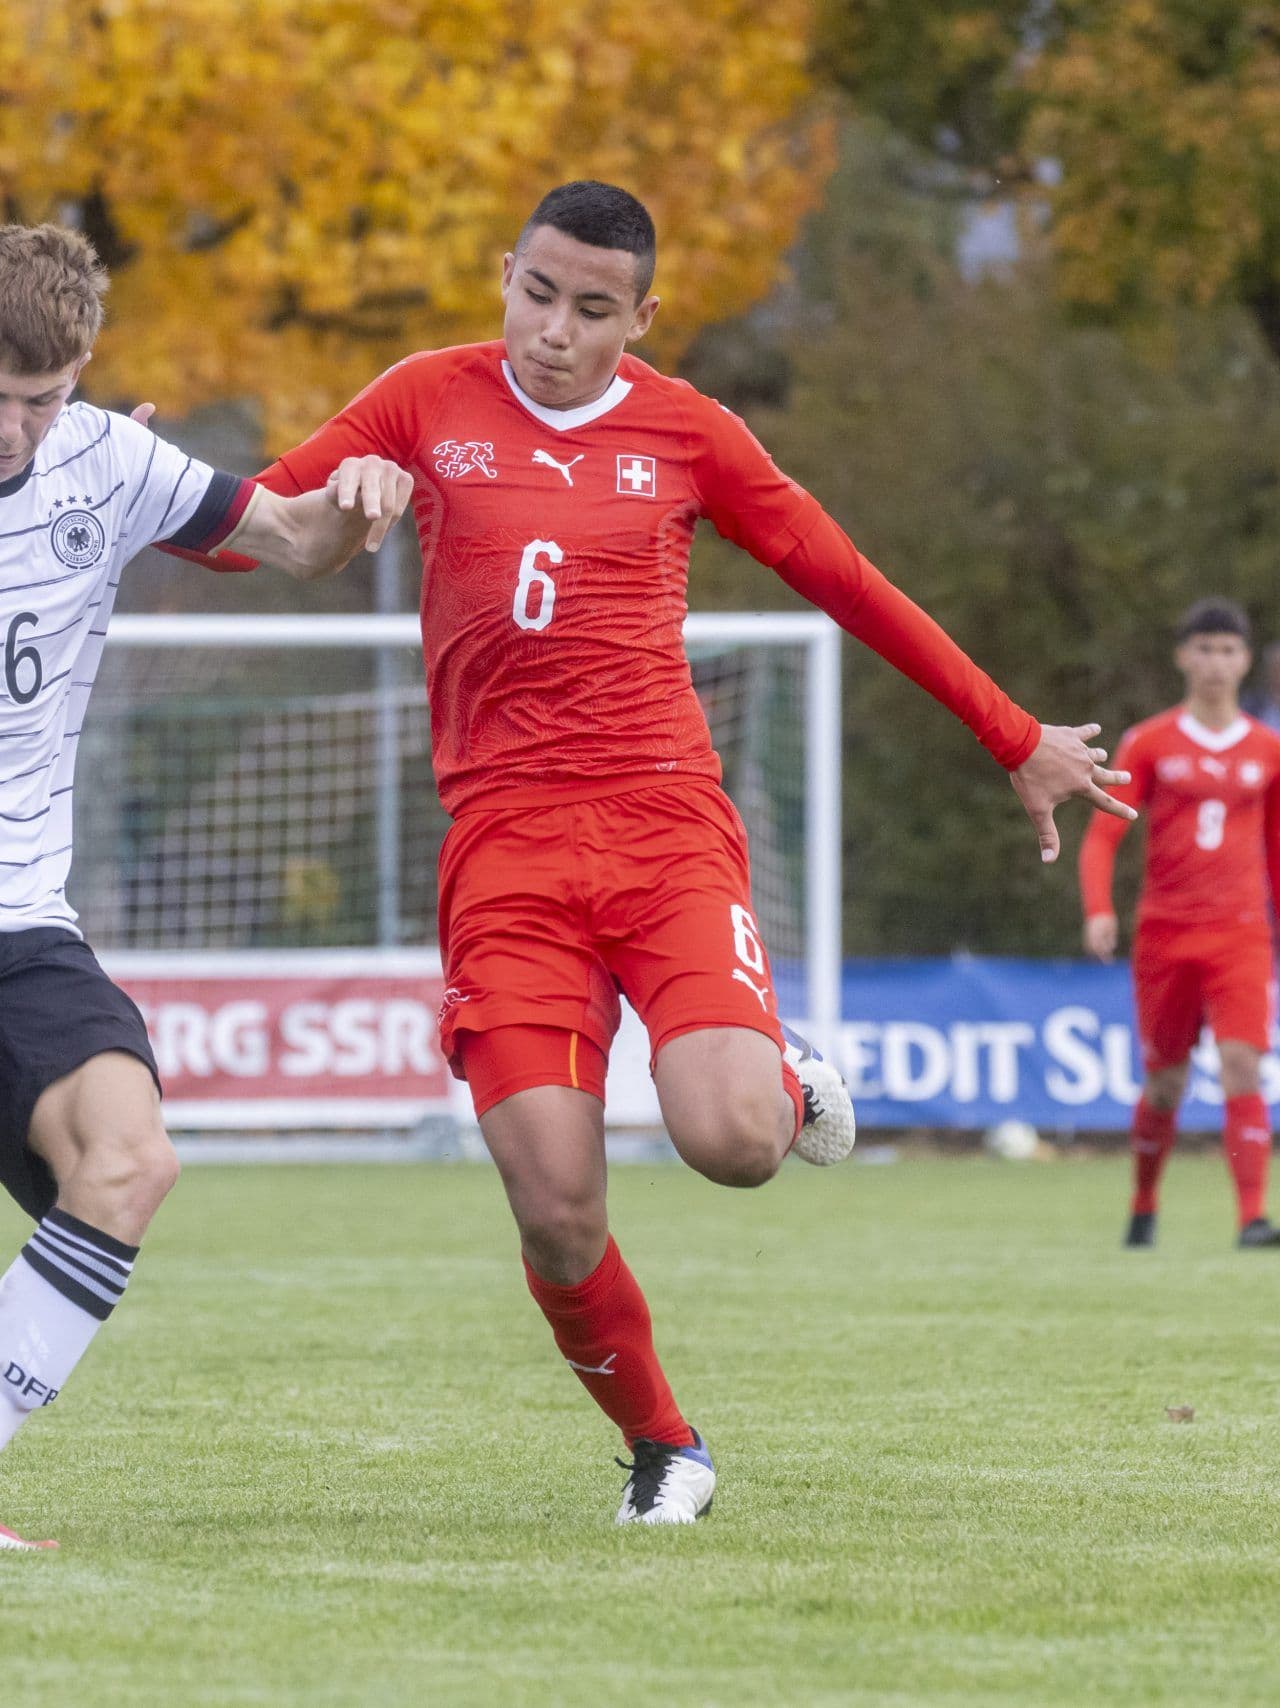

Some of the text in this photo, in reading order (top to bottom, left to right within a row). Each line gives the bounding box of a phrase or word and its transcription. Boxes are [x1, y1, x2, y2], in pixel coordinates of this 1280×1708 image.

[512, 538, 563, 631] 6
[5, 611, 43, 704] 6
[730, 904, 764, 976] 6
[150, 1001, 269, 1078] RG
[279, 1000, 436, 1076] SSR
[810, 1020, 1035, 1102] EDIT
